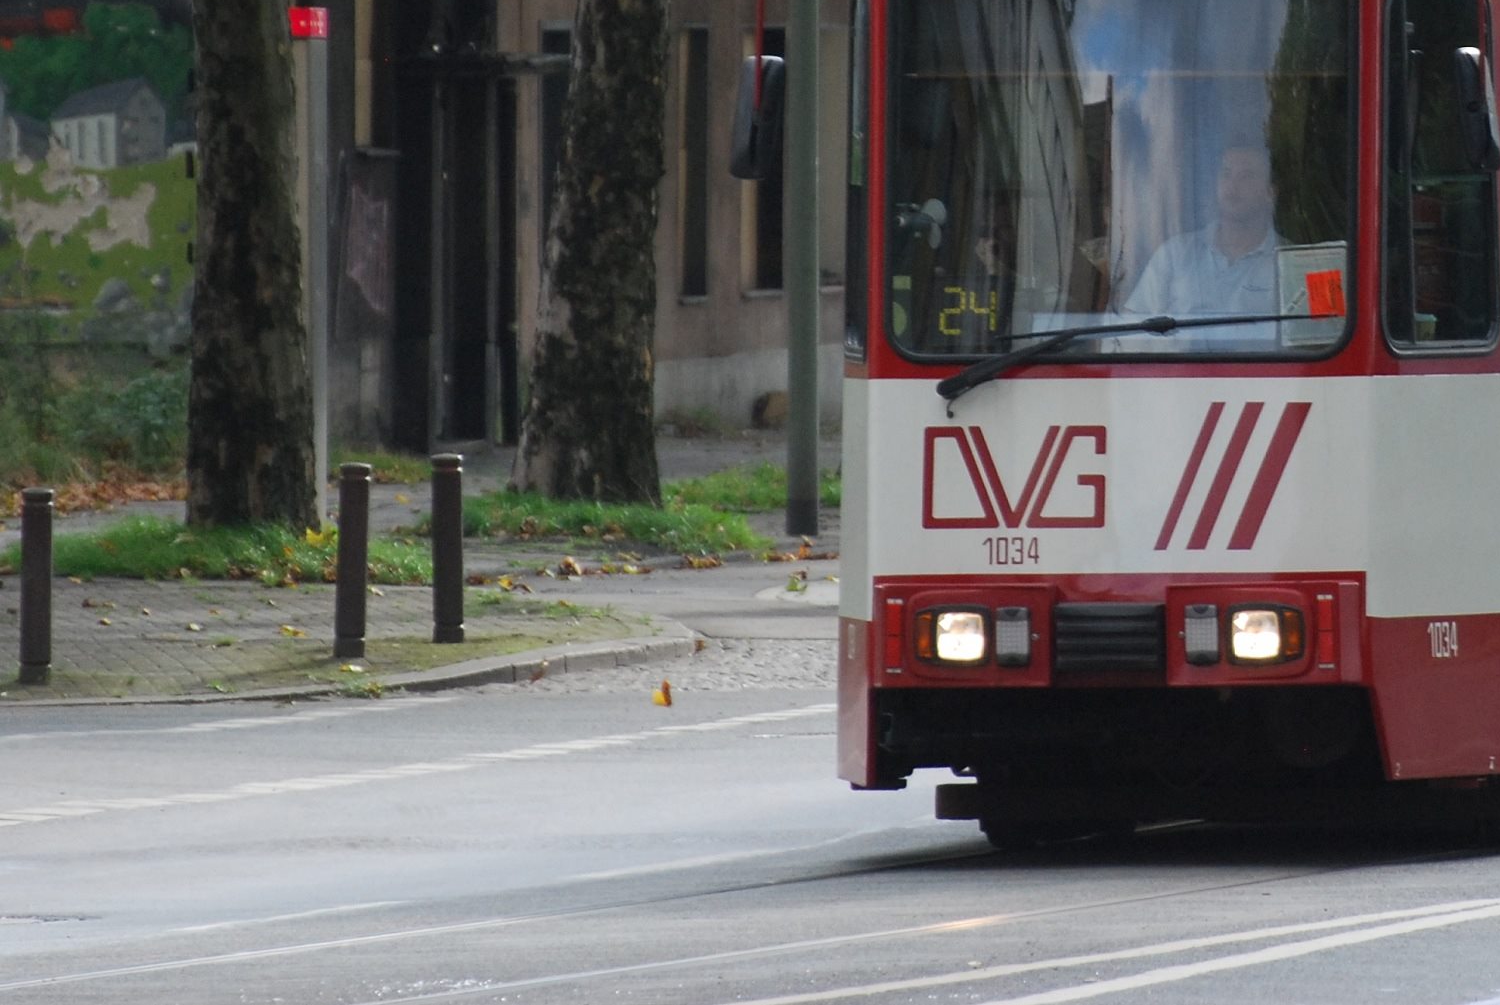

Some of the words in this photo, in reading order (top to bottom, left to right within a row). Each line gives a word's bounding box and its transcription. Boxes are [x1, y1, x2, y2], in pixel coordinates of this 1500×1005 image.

[939, 287, 996, 336] 24
[922, 426, 1106, 528] DVG
[982, 537, 1040, 565] 1034
[1427, 621, 1458, 658] 1034
